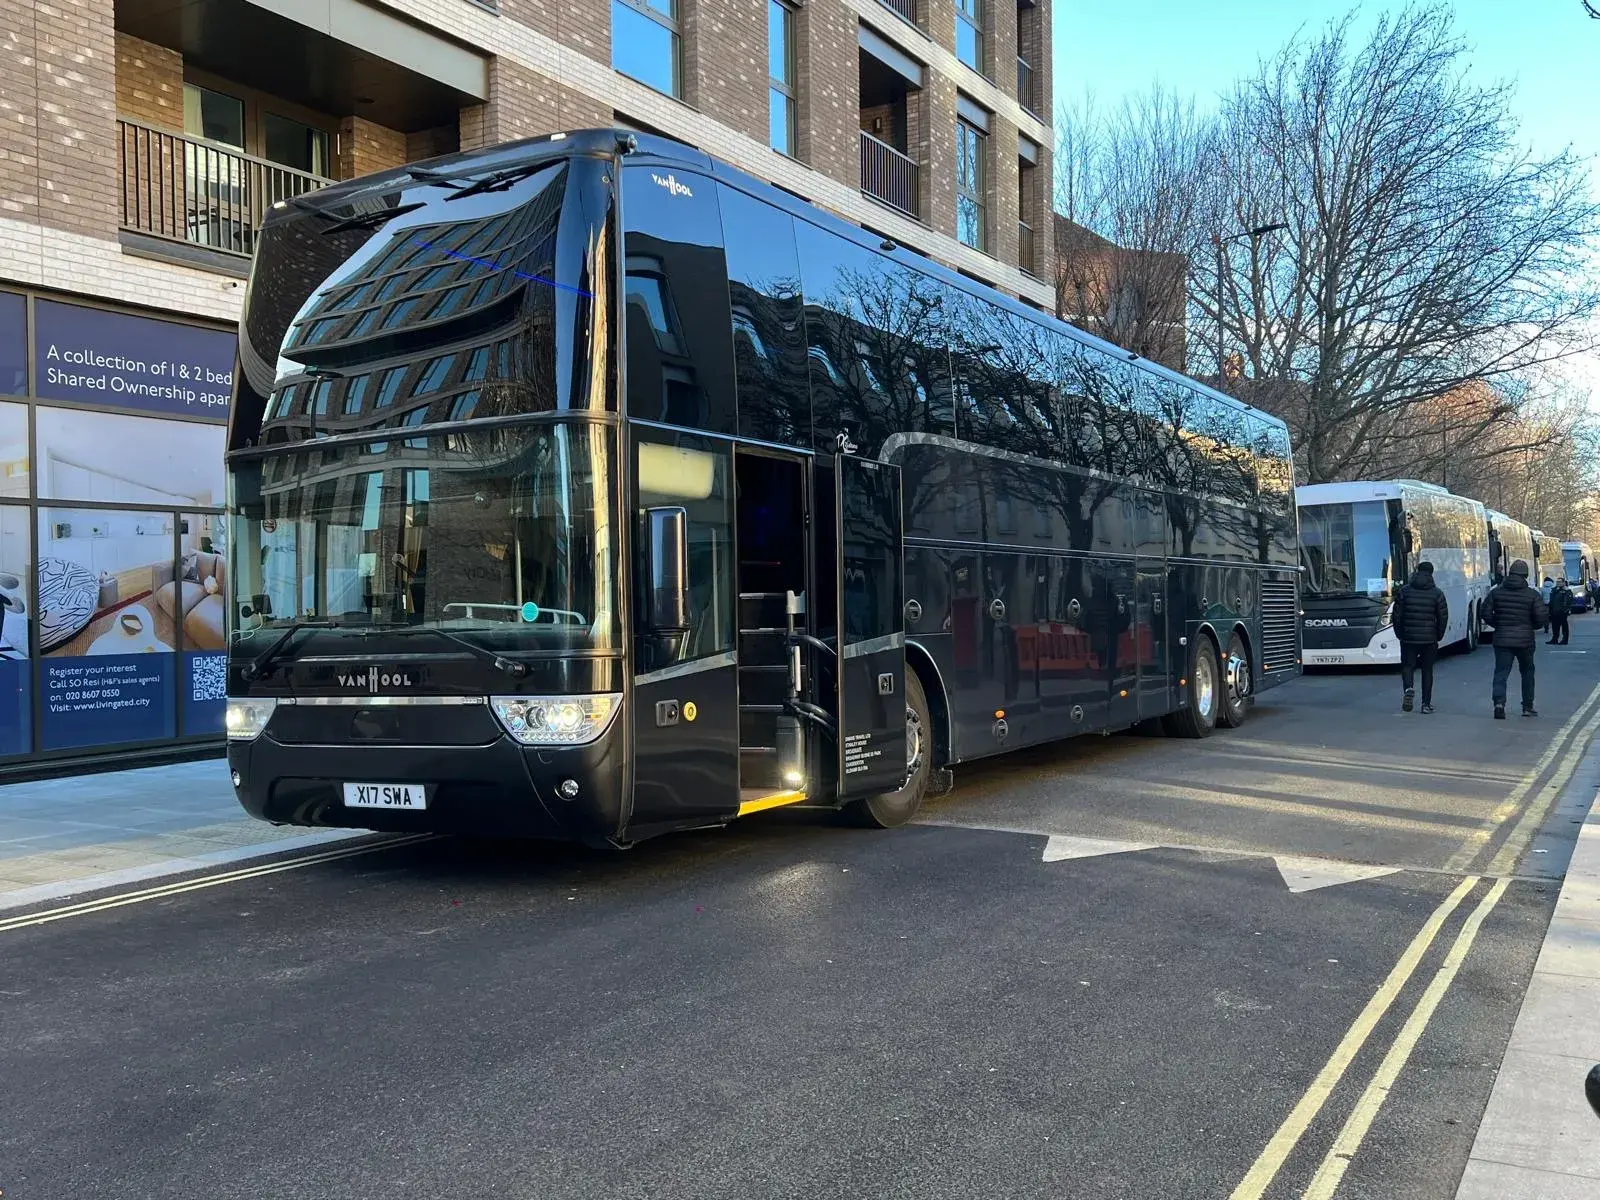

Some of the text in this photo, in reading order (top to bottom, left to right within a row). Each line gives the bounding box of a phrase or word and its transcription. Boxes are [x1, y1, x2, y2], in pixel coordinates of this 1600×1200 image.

[47, 344, 60, 361] A
[63, 349, 146, 373] collection
[150, 361, 167, 376] of
[179, 364, 190, 380] &
[194, 366, 202, 381] 2
[206, 368, 233, 385] bed
[47, 368, 231, 407] Shared Ownership apar
[1305, 618, 1348, 627] SCANIA
[49, 664, 137, 678] Register your interest
[49, 679, 67, 689] Call
[69, 677, 81, 688] SO
[83, 676, 100, 686] Resi
[122, 676, 138, 684] sales
[65, 691, 80, 701] 020
[81, 690, 100, 699] 8607
[101, 688, 120, 698] 0550
[50, 703, 72, 713] Visit:
[357, 786, 412, 806] X17 SWA
